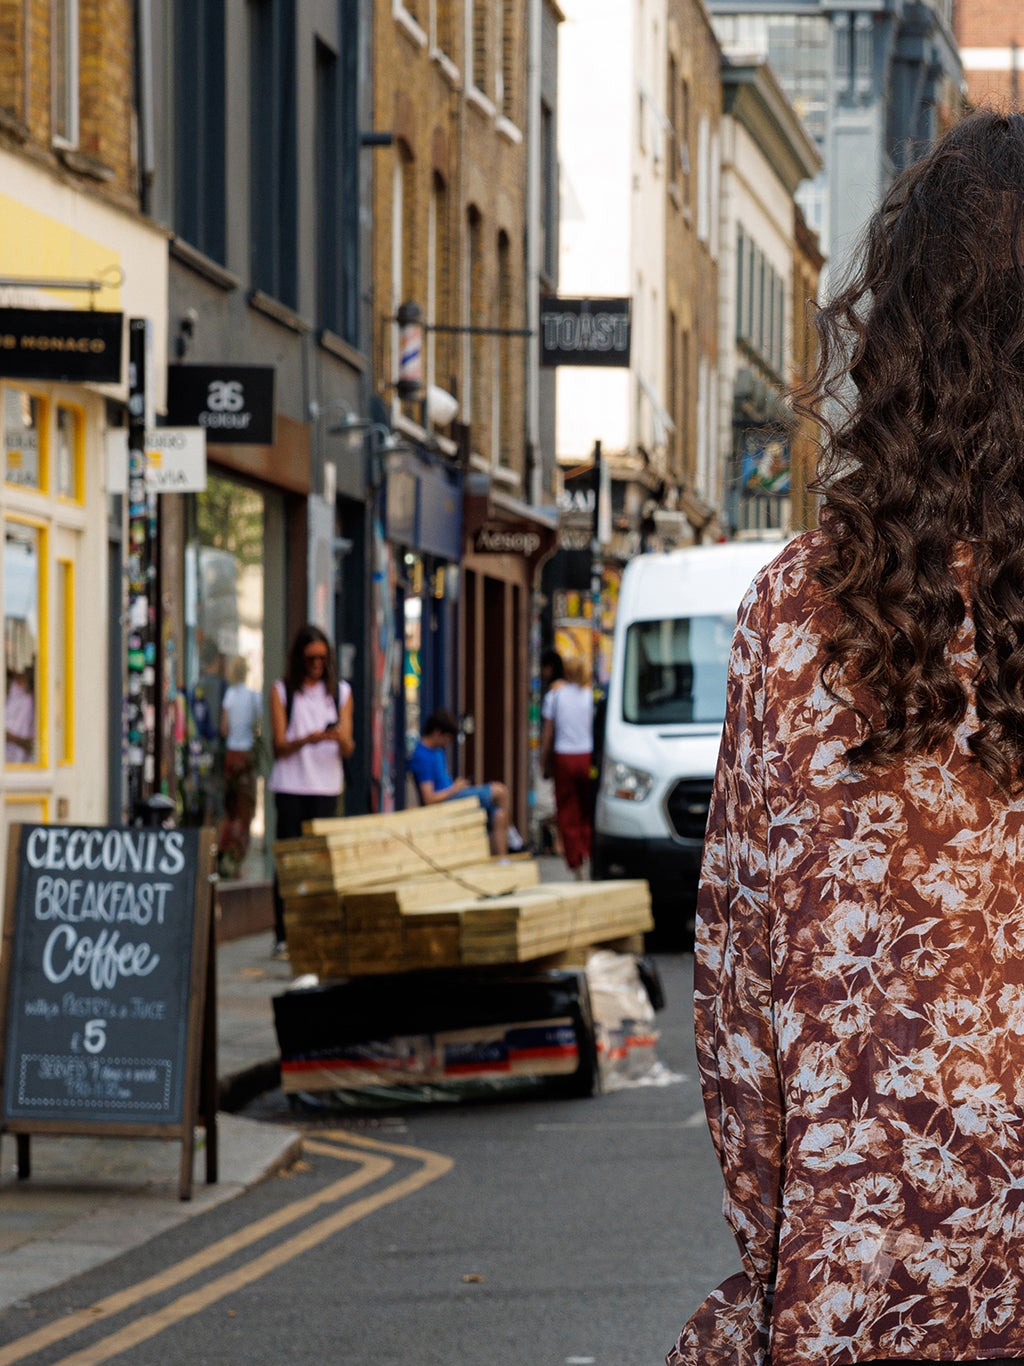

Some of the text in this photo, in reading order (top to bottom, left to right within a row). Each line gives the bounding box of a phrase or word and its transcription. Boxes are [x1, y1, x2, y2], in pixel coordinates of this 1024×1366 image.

[20, 335, 106, 353] MONACO
[542, 311, 628, 351] TOAST
[477, 528, 541, 557] Aesop
[26, 827, 186, 875] CECCONI'S
[35, 875, 174, 925] BREAKFAST
[42, 923, 161, 990] Coffee
